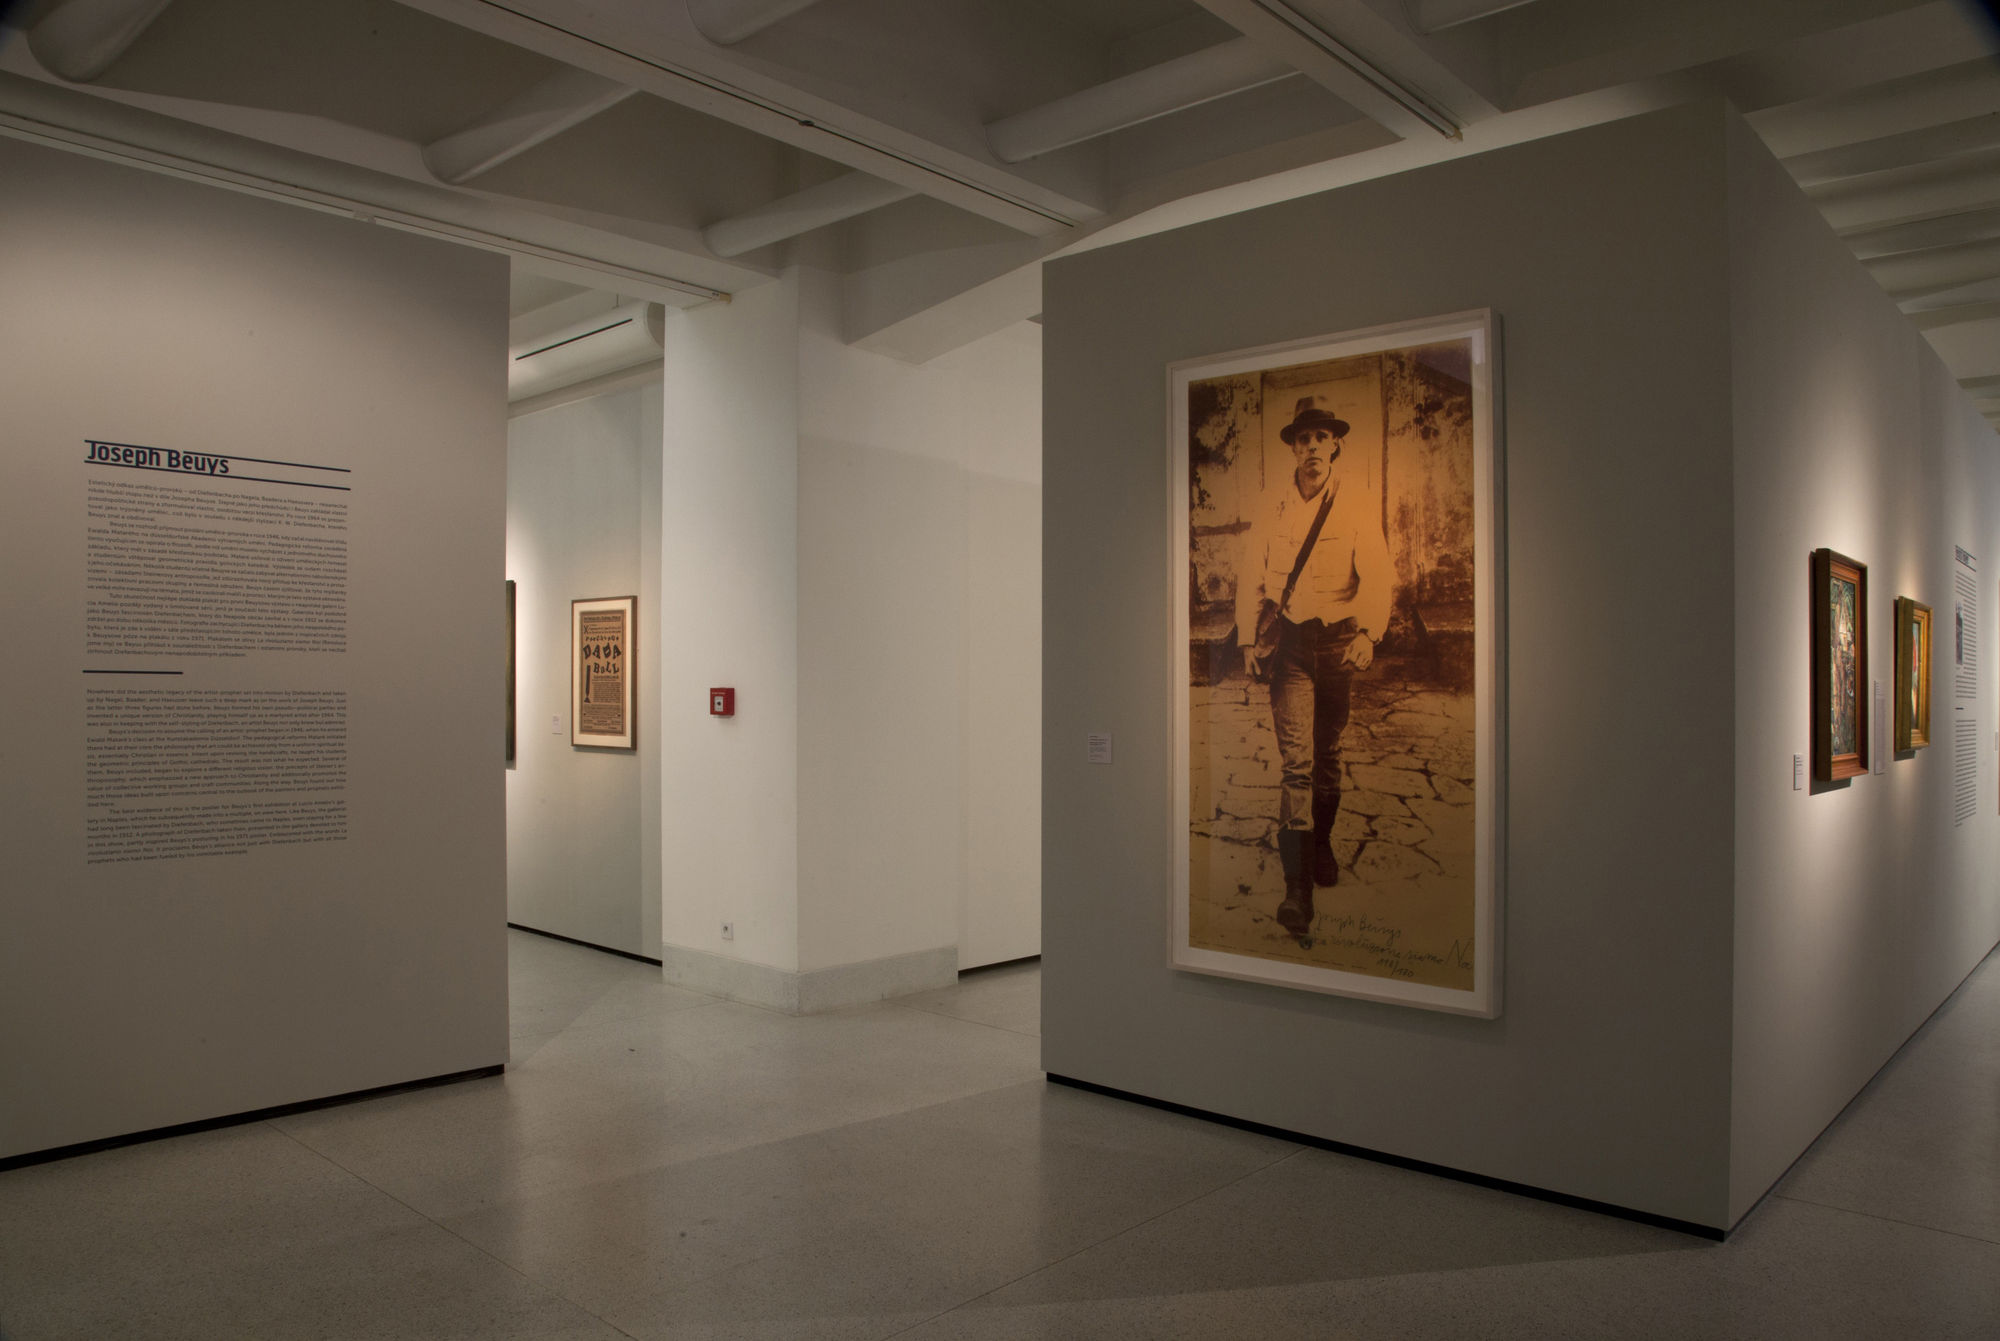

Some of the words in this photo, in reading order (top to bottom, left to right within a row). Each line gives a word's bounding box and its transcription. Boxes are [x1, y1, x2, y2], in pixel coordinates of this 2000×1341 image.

[88, 442, 160, 467] Joseph
[168, 450, 229, 475] Beuys
[583, 643, 621, 659] DADA
